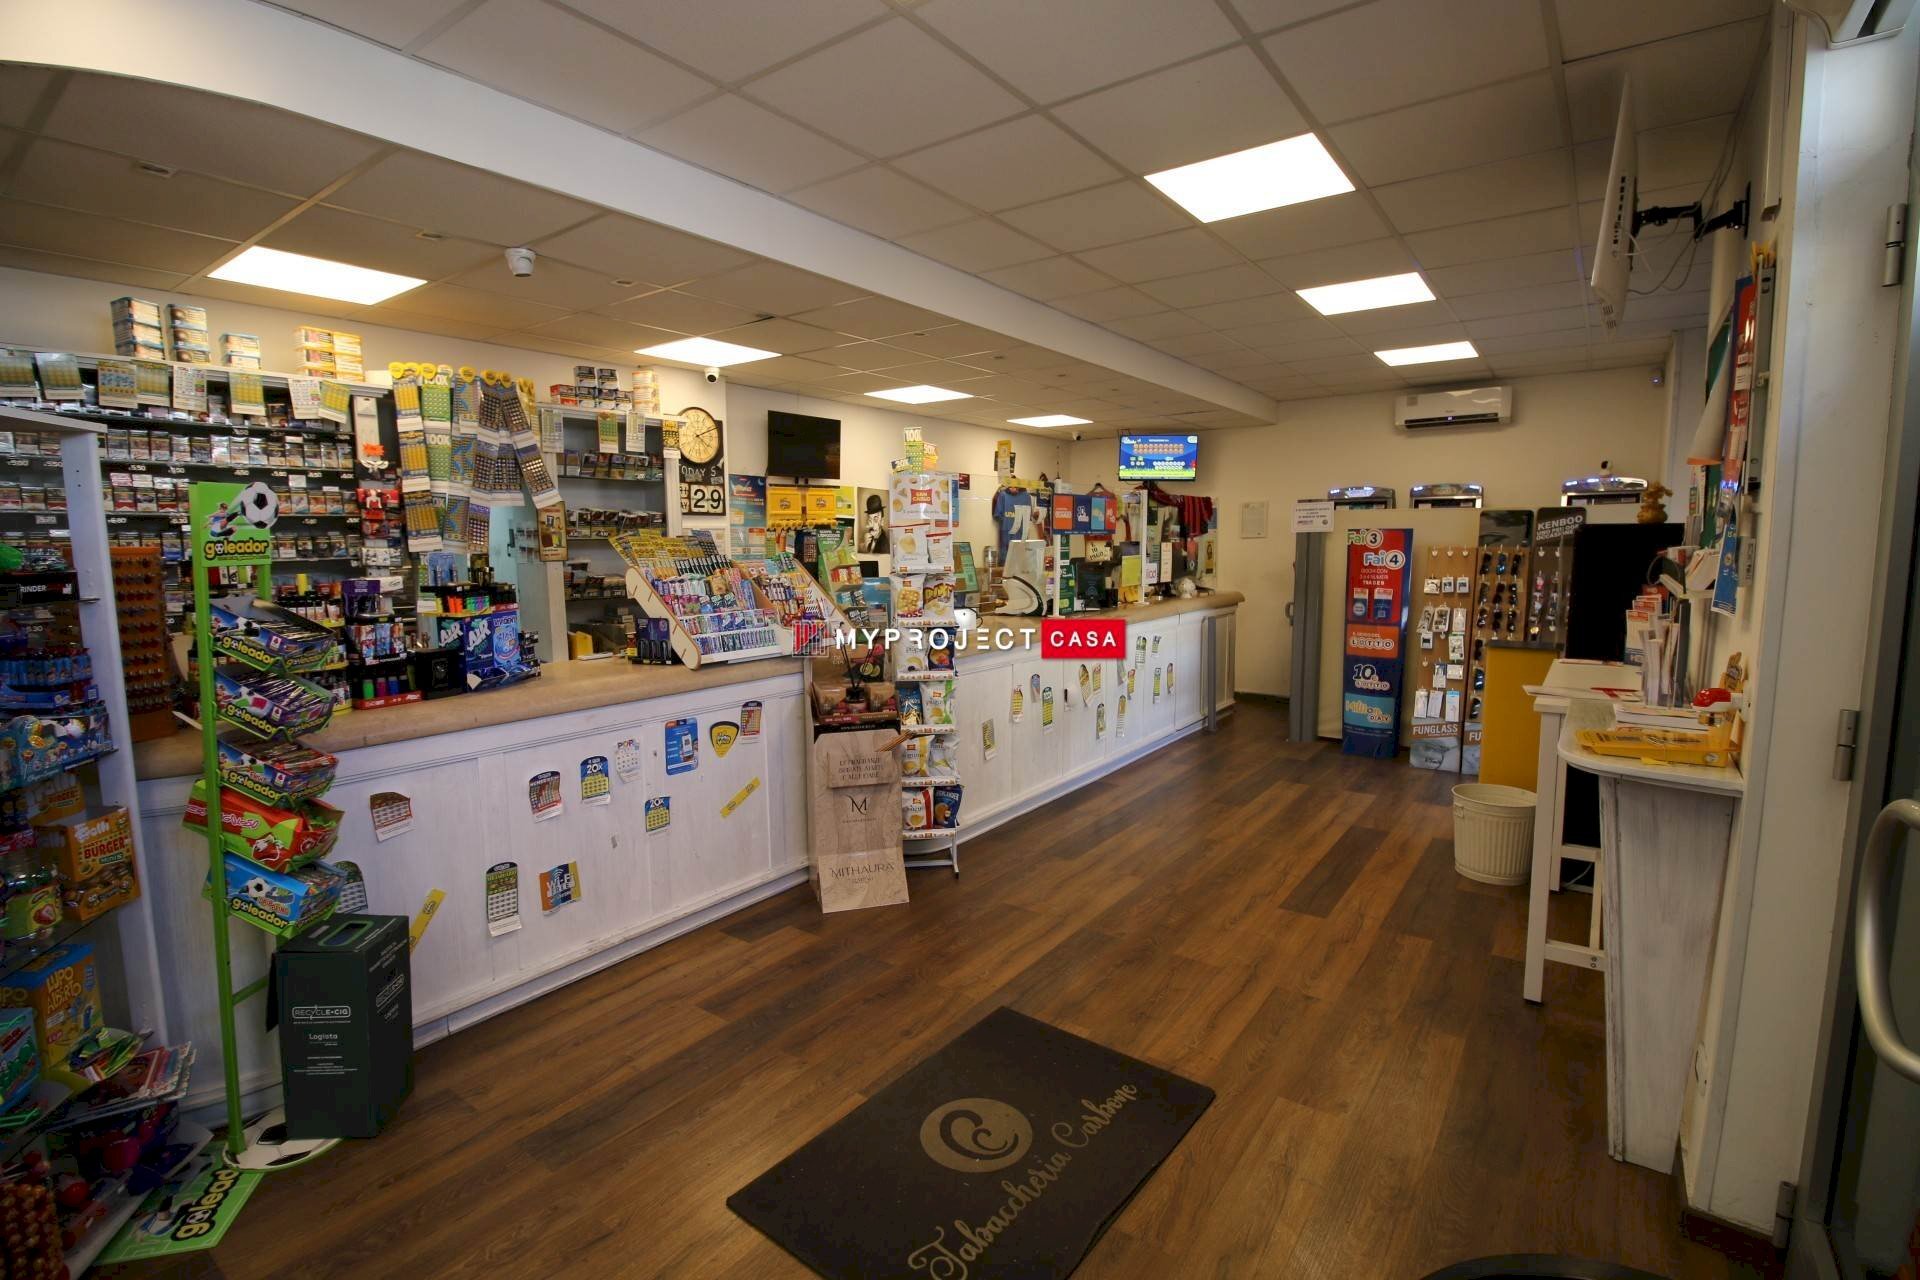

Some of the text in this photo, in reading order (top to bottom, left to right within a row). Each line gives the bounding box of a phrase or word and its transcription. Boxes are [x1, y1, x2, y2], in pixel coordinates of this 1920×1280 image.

[693, 488, 722, 510] 29
[1537, 515, 1584, 531] KENBOO
[204, 538, 269, 560] goleador
[1351, 636, 1395, 651] LOTTO
[1353, 664, 1377, 681] 10
[1412, 724, 1458, 736] FUNGLASS
[83, 837, 127, 859] BURGER
[830, 862, 895, 880] MITHAURA
[231, 896, 288, 928] goleador
[1050, 1081, 1138, 1149] Carbone
